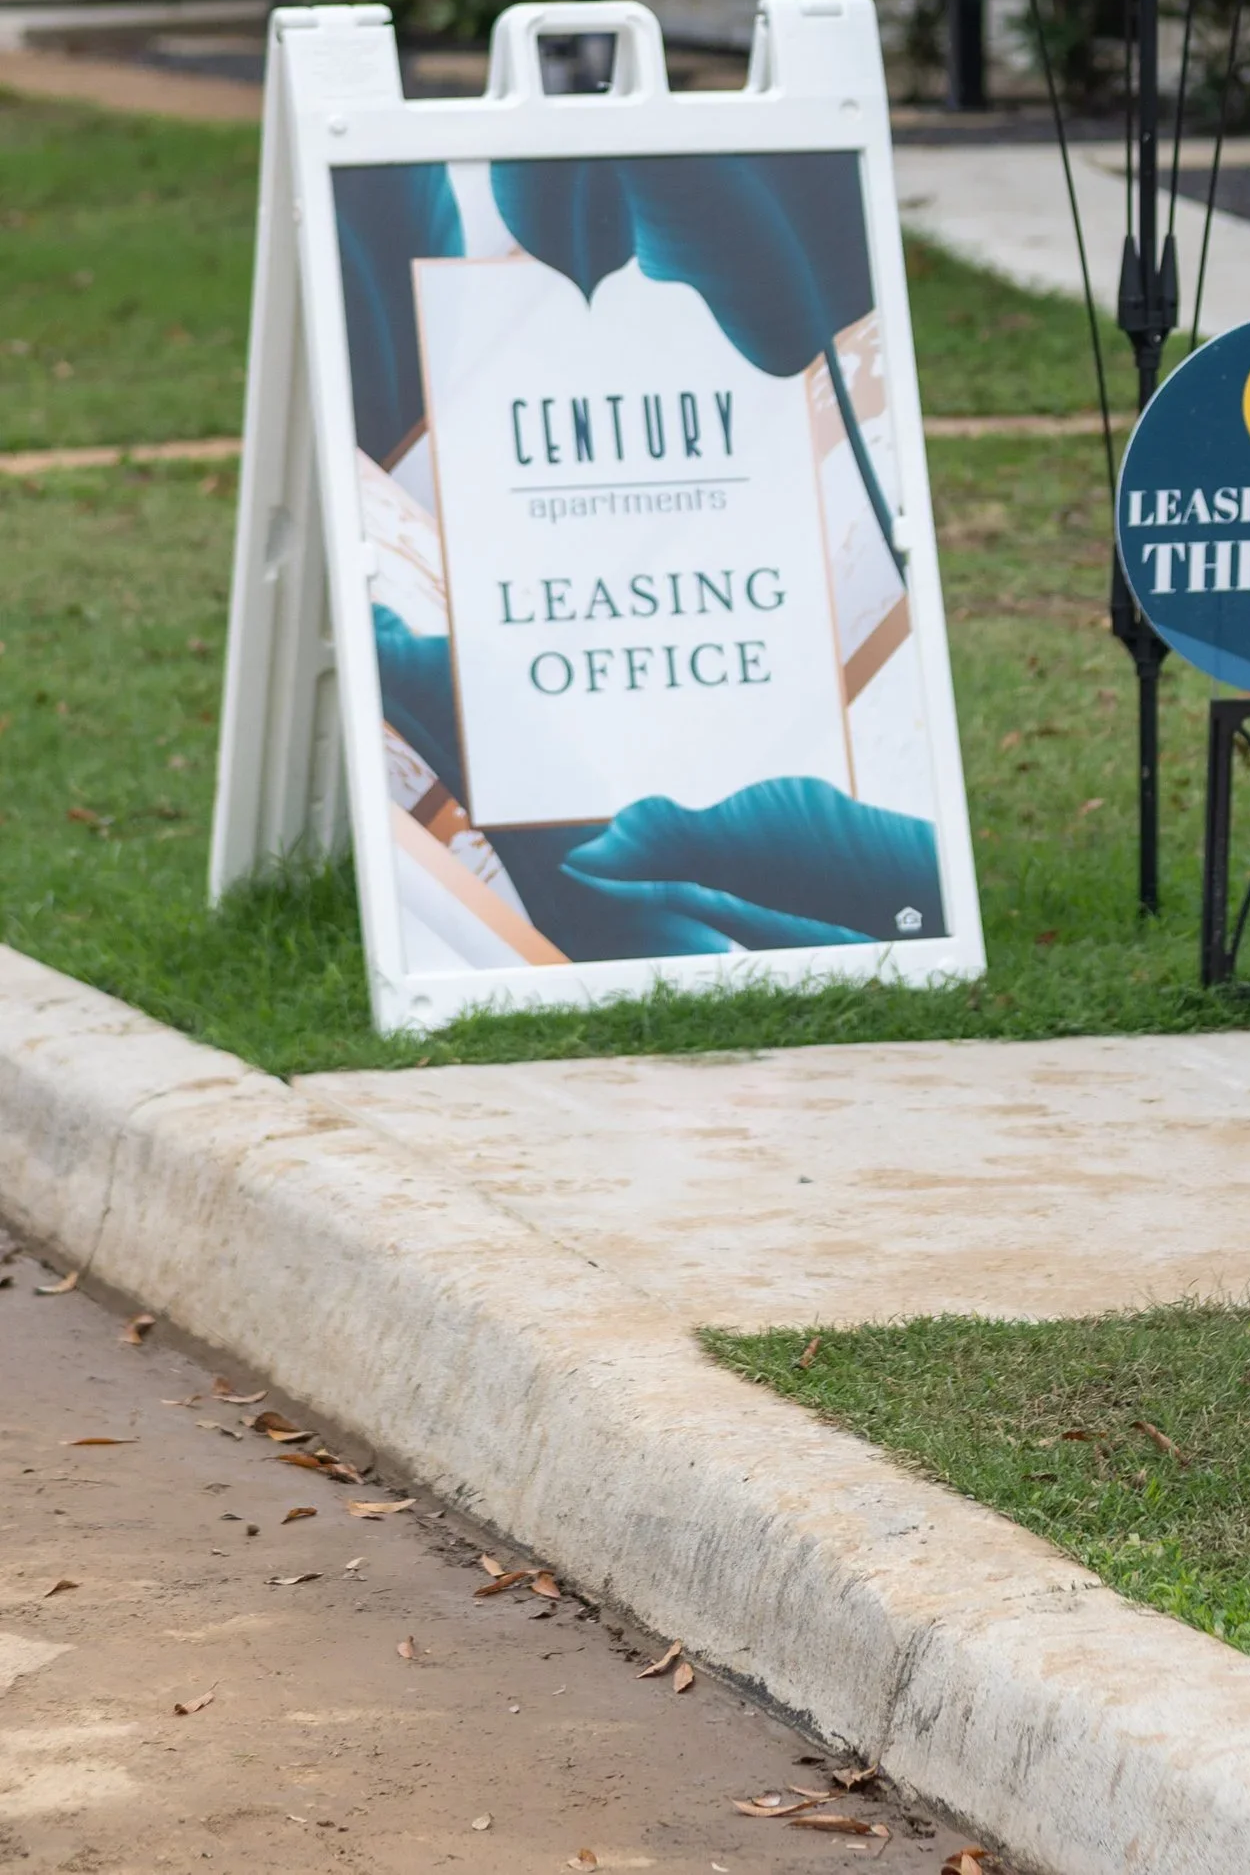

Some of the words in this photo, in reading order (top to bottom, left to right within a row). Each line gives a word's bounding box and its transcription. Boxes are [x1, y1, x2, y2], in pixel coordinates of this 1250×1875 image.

[510, 390, 733, 466] CENTURY
[528, 488, 728, 524] apartments
[497, 567, 787, 625] LEASING
[528, 640, 772, 696] OFFICE
